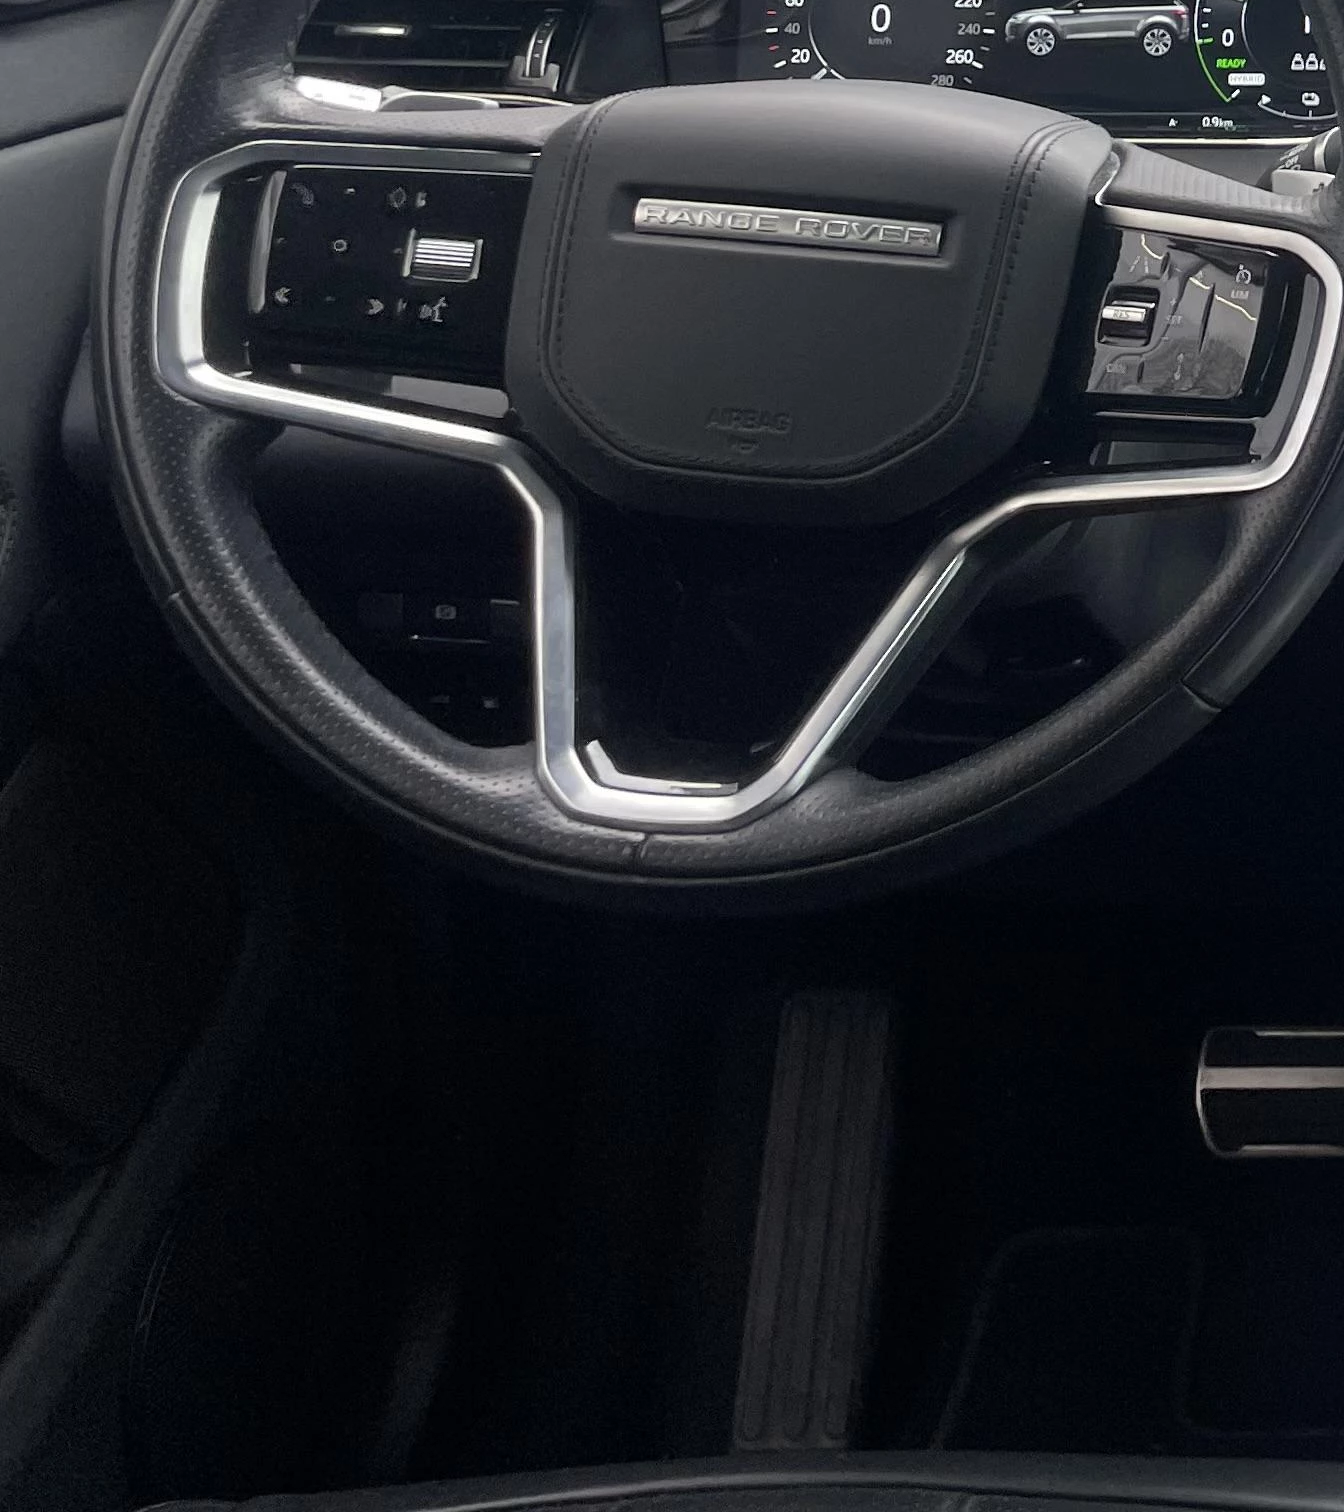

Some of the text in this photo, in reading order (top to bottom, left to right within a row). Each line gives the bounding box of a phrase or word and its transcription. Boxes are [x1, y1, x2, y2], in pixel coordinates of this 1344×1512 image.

[871, 4, 891, 32] 0
[784, 23, 800, 34] 40
[957, 23, 981, 35] 240
[868, 37, 892, 45] km/h
[1221, 29, 1234, 47] 0
[791, 49, 811, 64] 20
[946, 49, 974, 64] 260
[1216, 58, 1247, 69] READY
[931, 75, 954, 87] 280
[1229, 74, 1265, 85] HYBRID
[643, 204, 932, 247] RANGE ROVER
